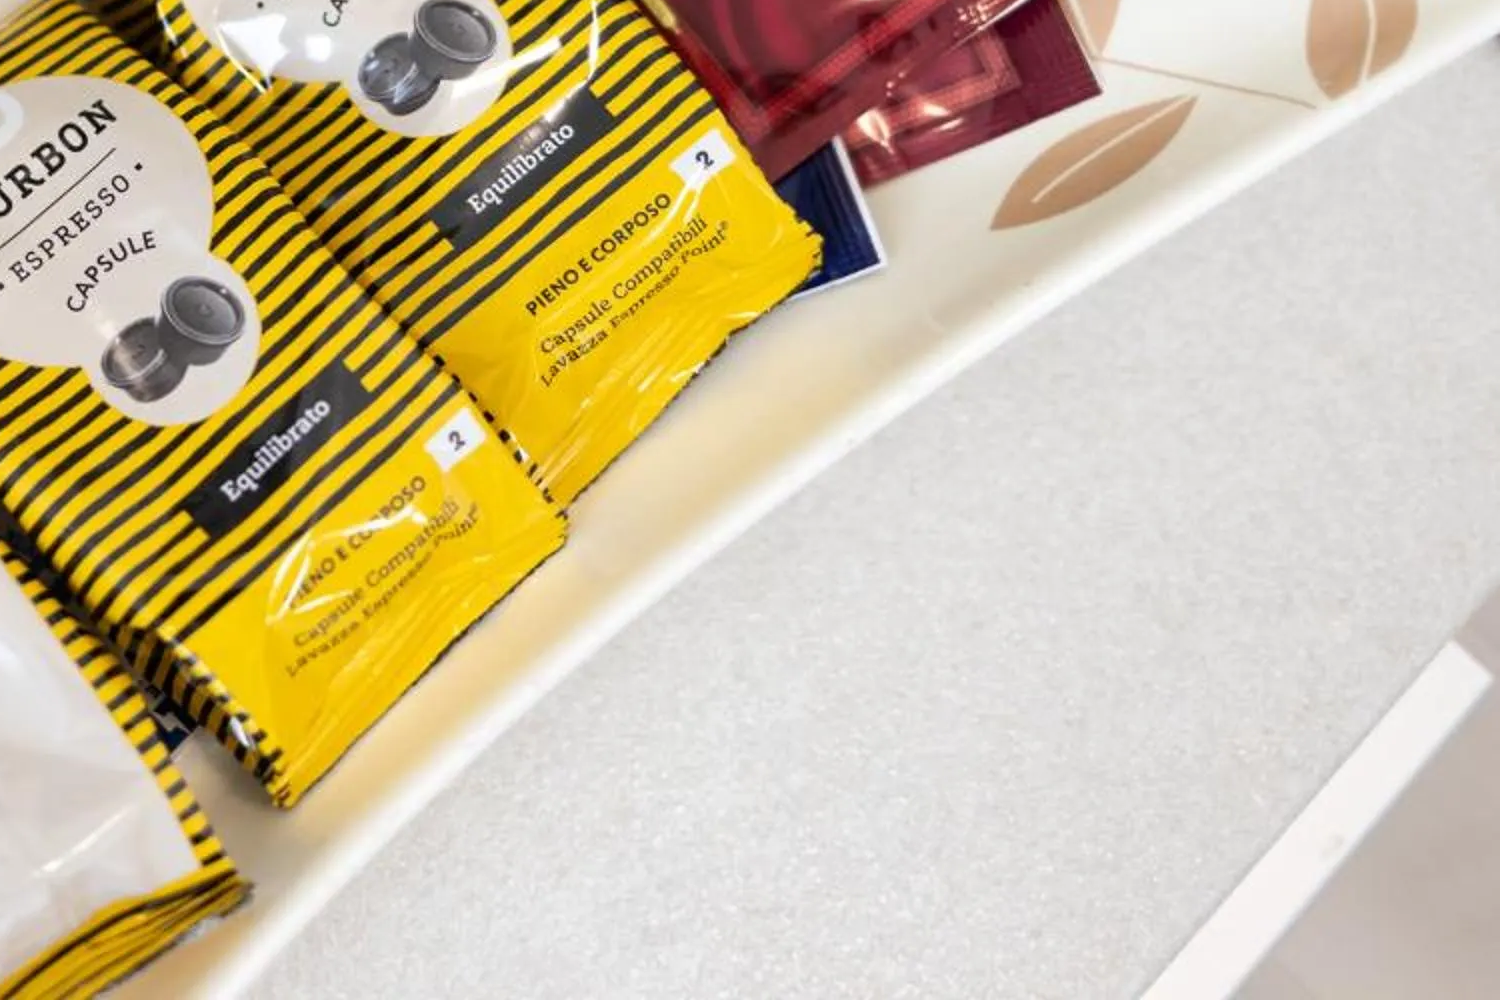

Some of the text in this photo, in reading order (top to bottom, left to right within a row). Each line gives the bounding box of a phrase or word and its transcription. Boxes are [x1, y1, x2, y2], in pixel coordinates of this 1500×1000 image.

[465, 121, 576, 218] Equilibrato
[694, 149, 715, 170] 2
[7, 173, 131, 284] ESPRESSO
[65, 228, 158, 315] CAPSULE
[525, 192, 671, 317] PIENO E CORPOSO
[539, 214, 709, 354] Capsule Compatibili
[539, 329, 609, 388] Lavazza
[220, 397, 332, 503] Equilibrato
[292, 585, 365, 648] Capsule
